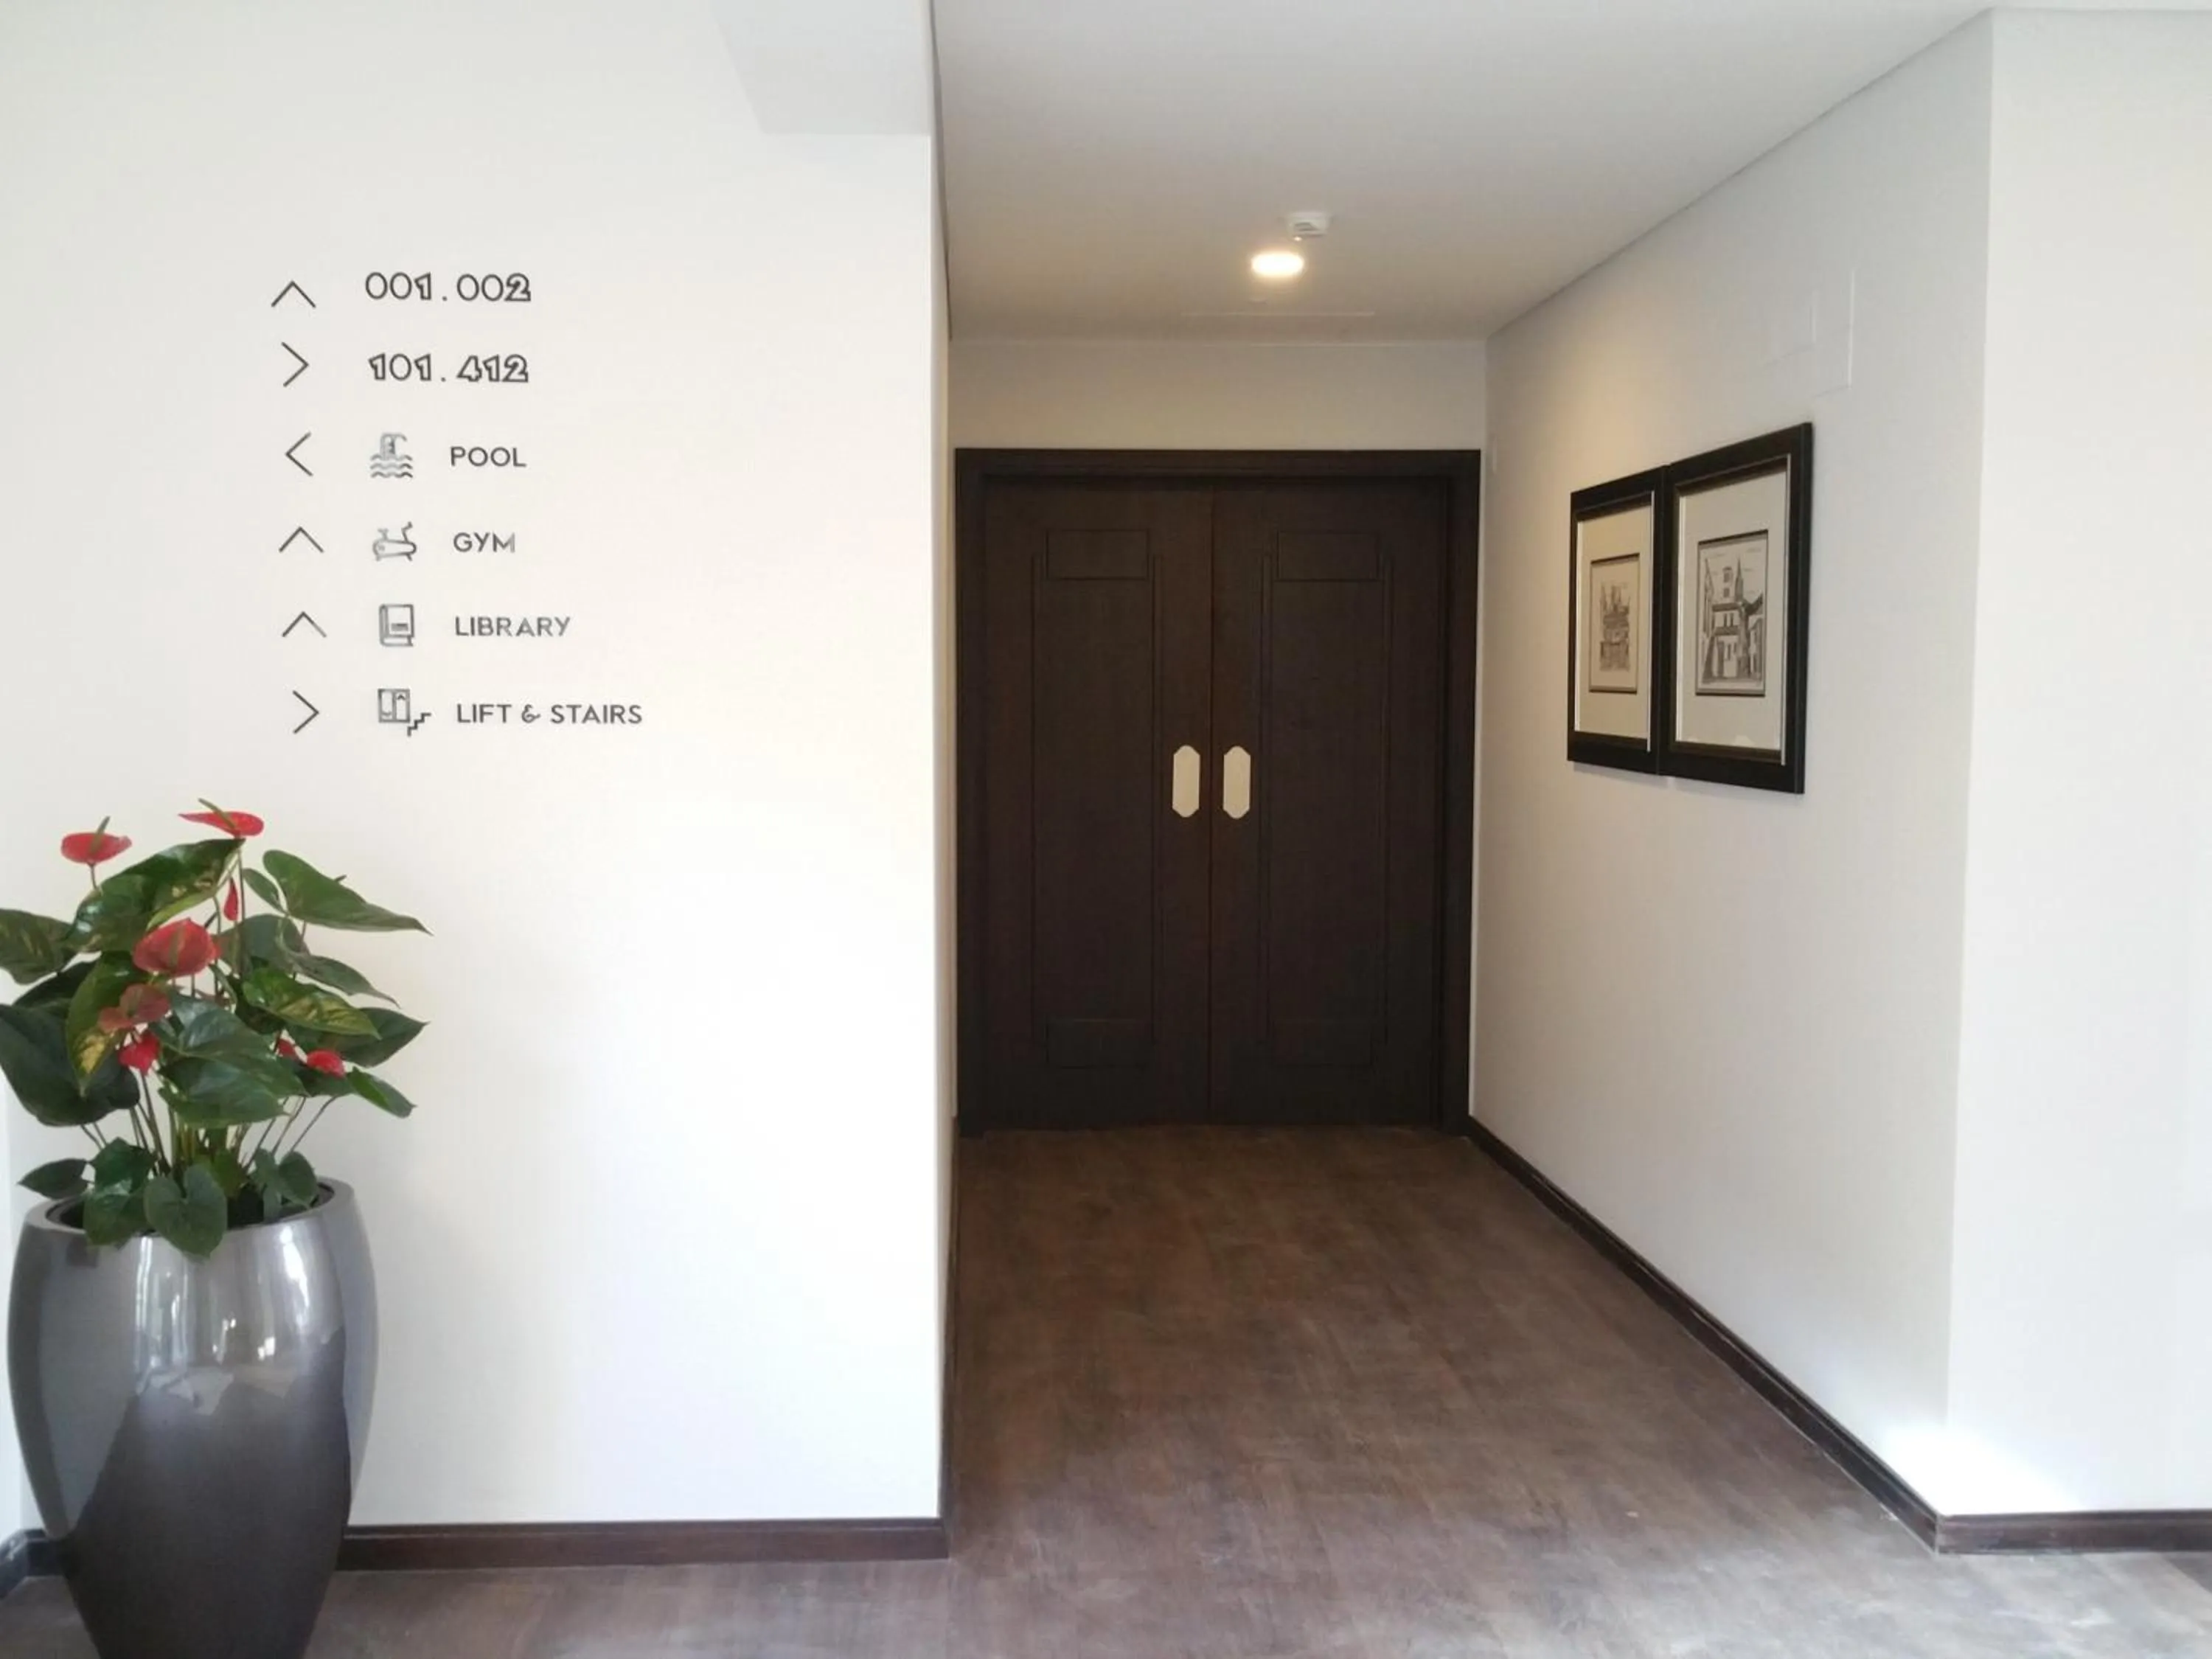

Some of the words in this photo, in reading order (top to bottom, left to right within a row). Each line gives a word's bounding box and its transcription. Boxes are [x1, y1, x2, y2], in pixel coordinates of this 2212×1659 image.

[450, 446, 527, 468] POOL
[453, 532, 516, 553] GYM
[455, 616, 571, 637] LIBRARY
[456, 703, 512, 724] LIFT
[521, 703, 542, 725] &
[551, 704, 643, 725] STAIRS
